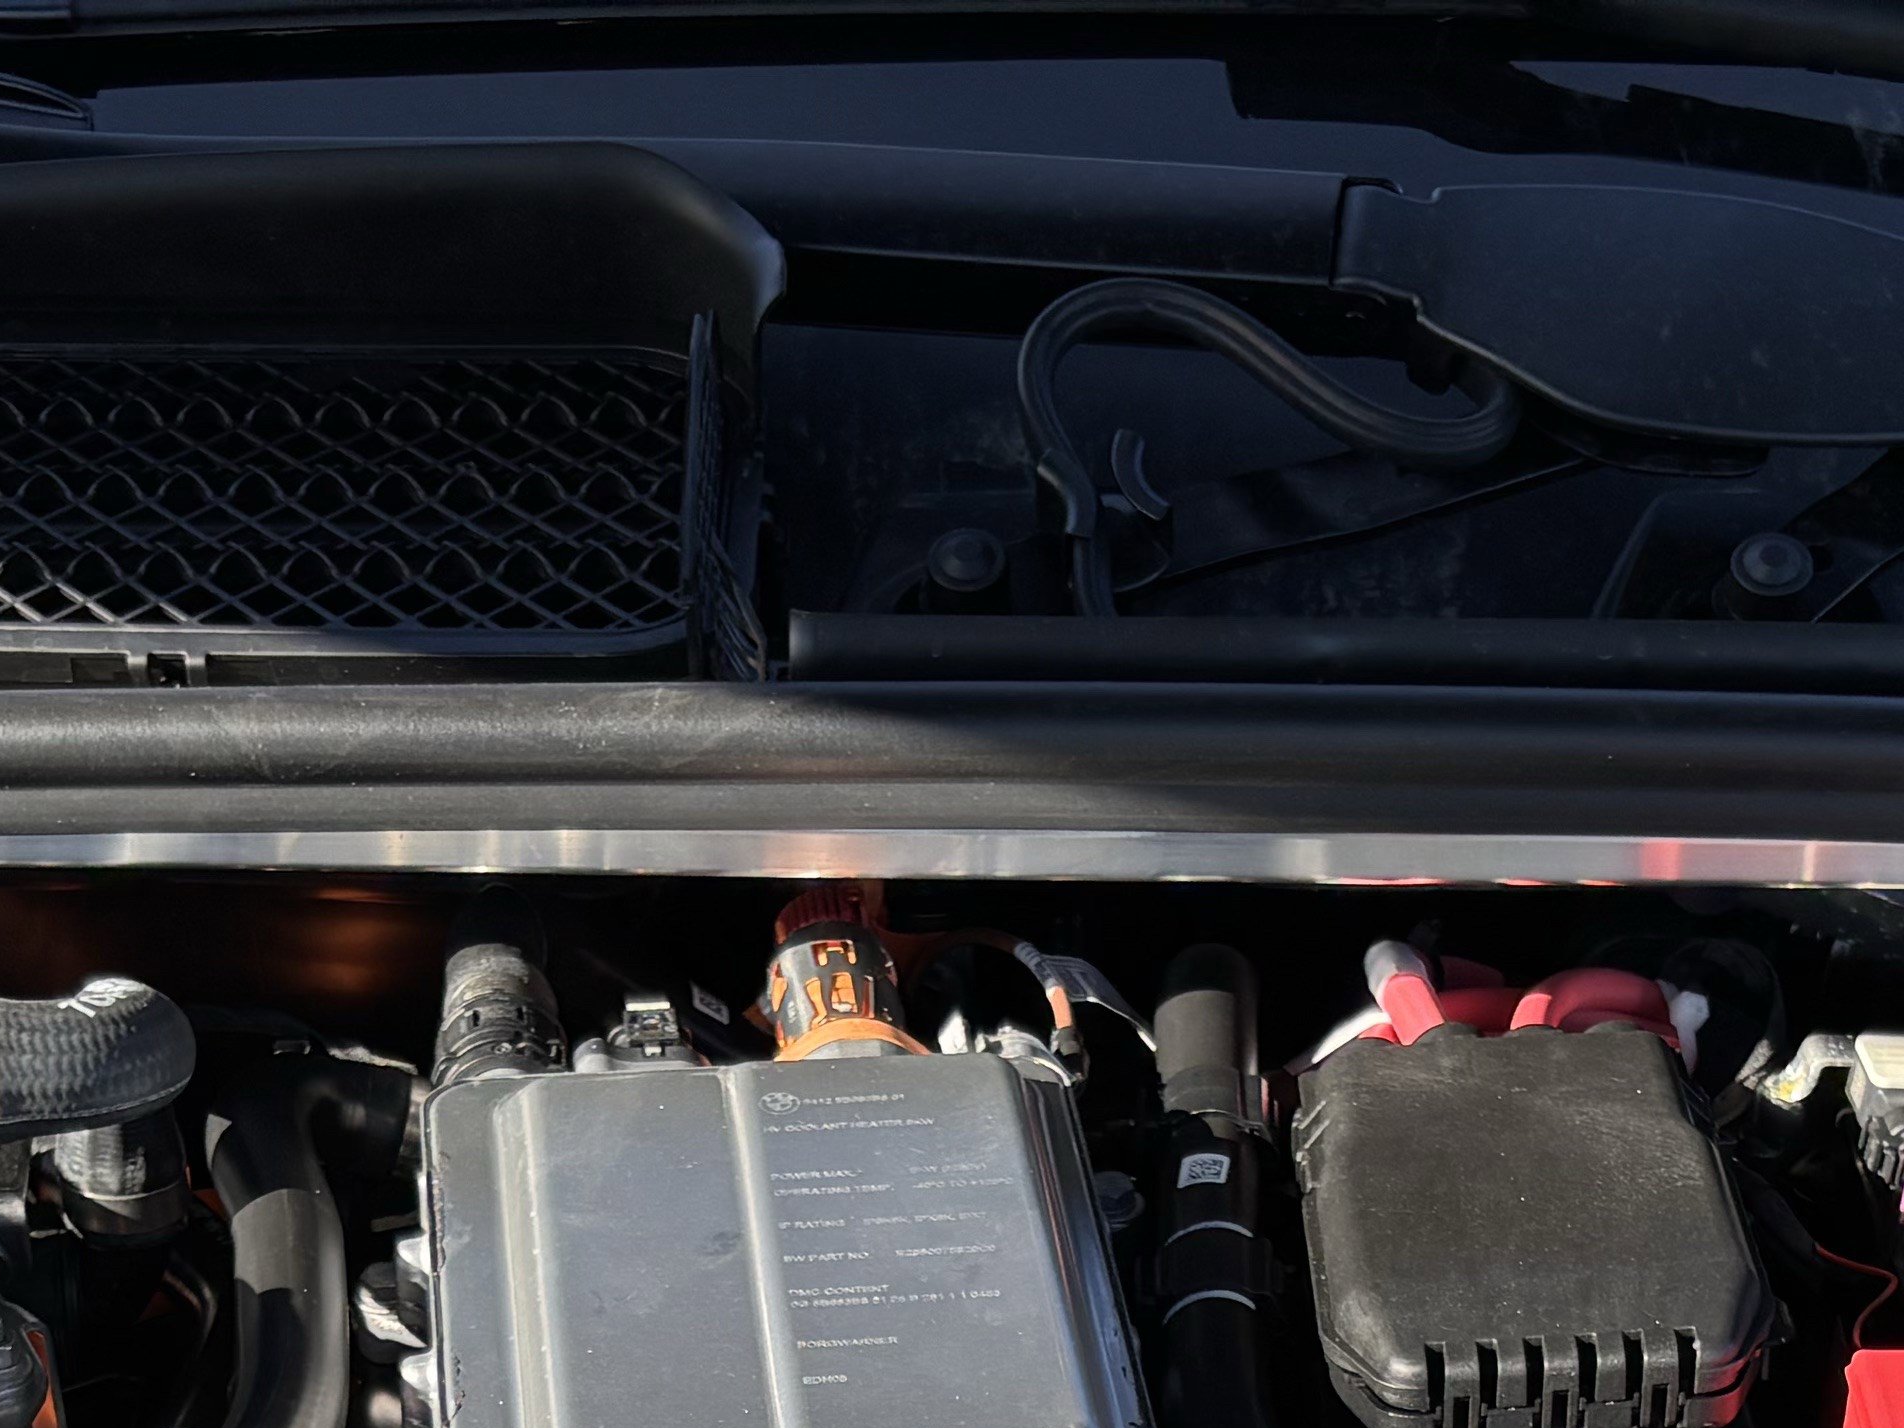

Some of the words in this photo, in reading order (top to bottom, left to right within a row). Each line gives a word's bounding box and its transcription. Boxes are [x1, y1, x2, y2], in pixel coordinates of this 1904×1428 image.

[785, 1121, 847, 1132] COOLANT
[850, 1119, 903, 1128] HEATER
[770, 1171, 820, 1180] POWER
[774, 1186, 851, 1196] OPERATING
[808, 1253, 844, 1262] PART
[824, 1284, 890, 1295] CONTENT
